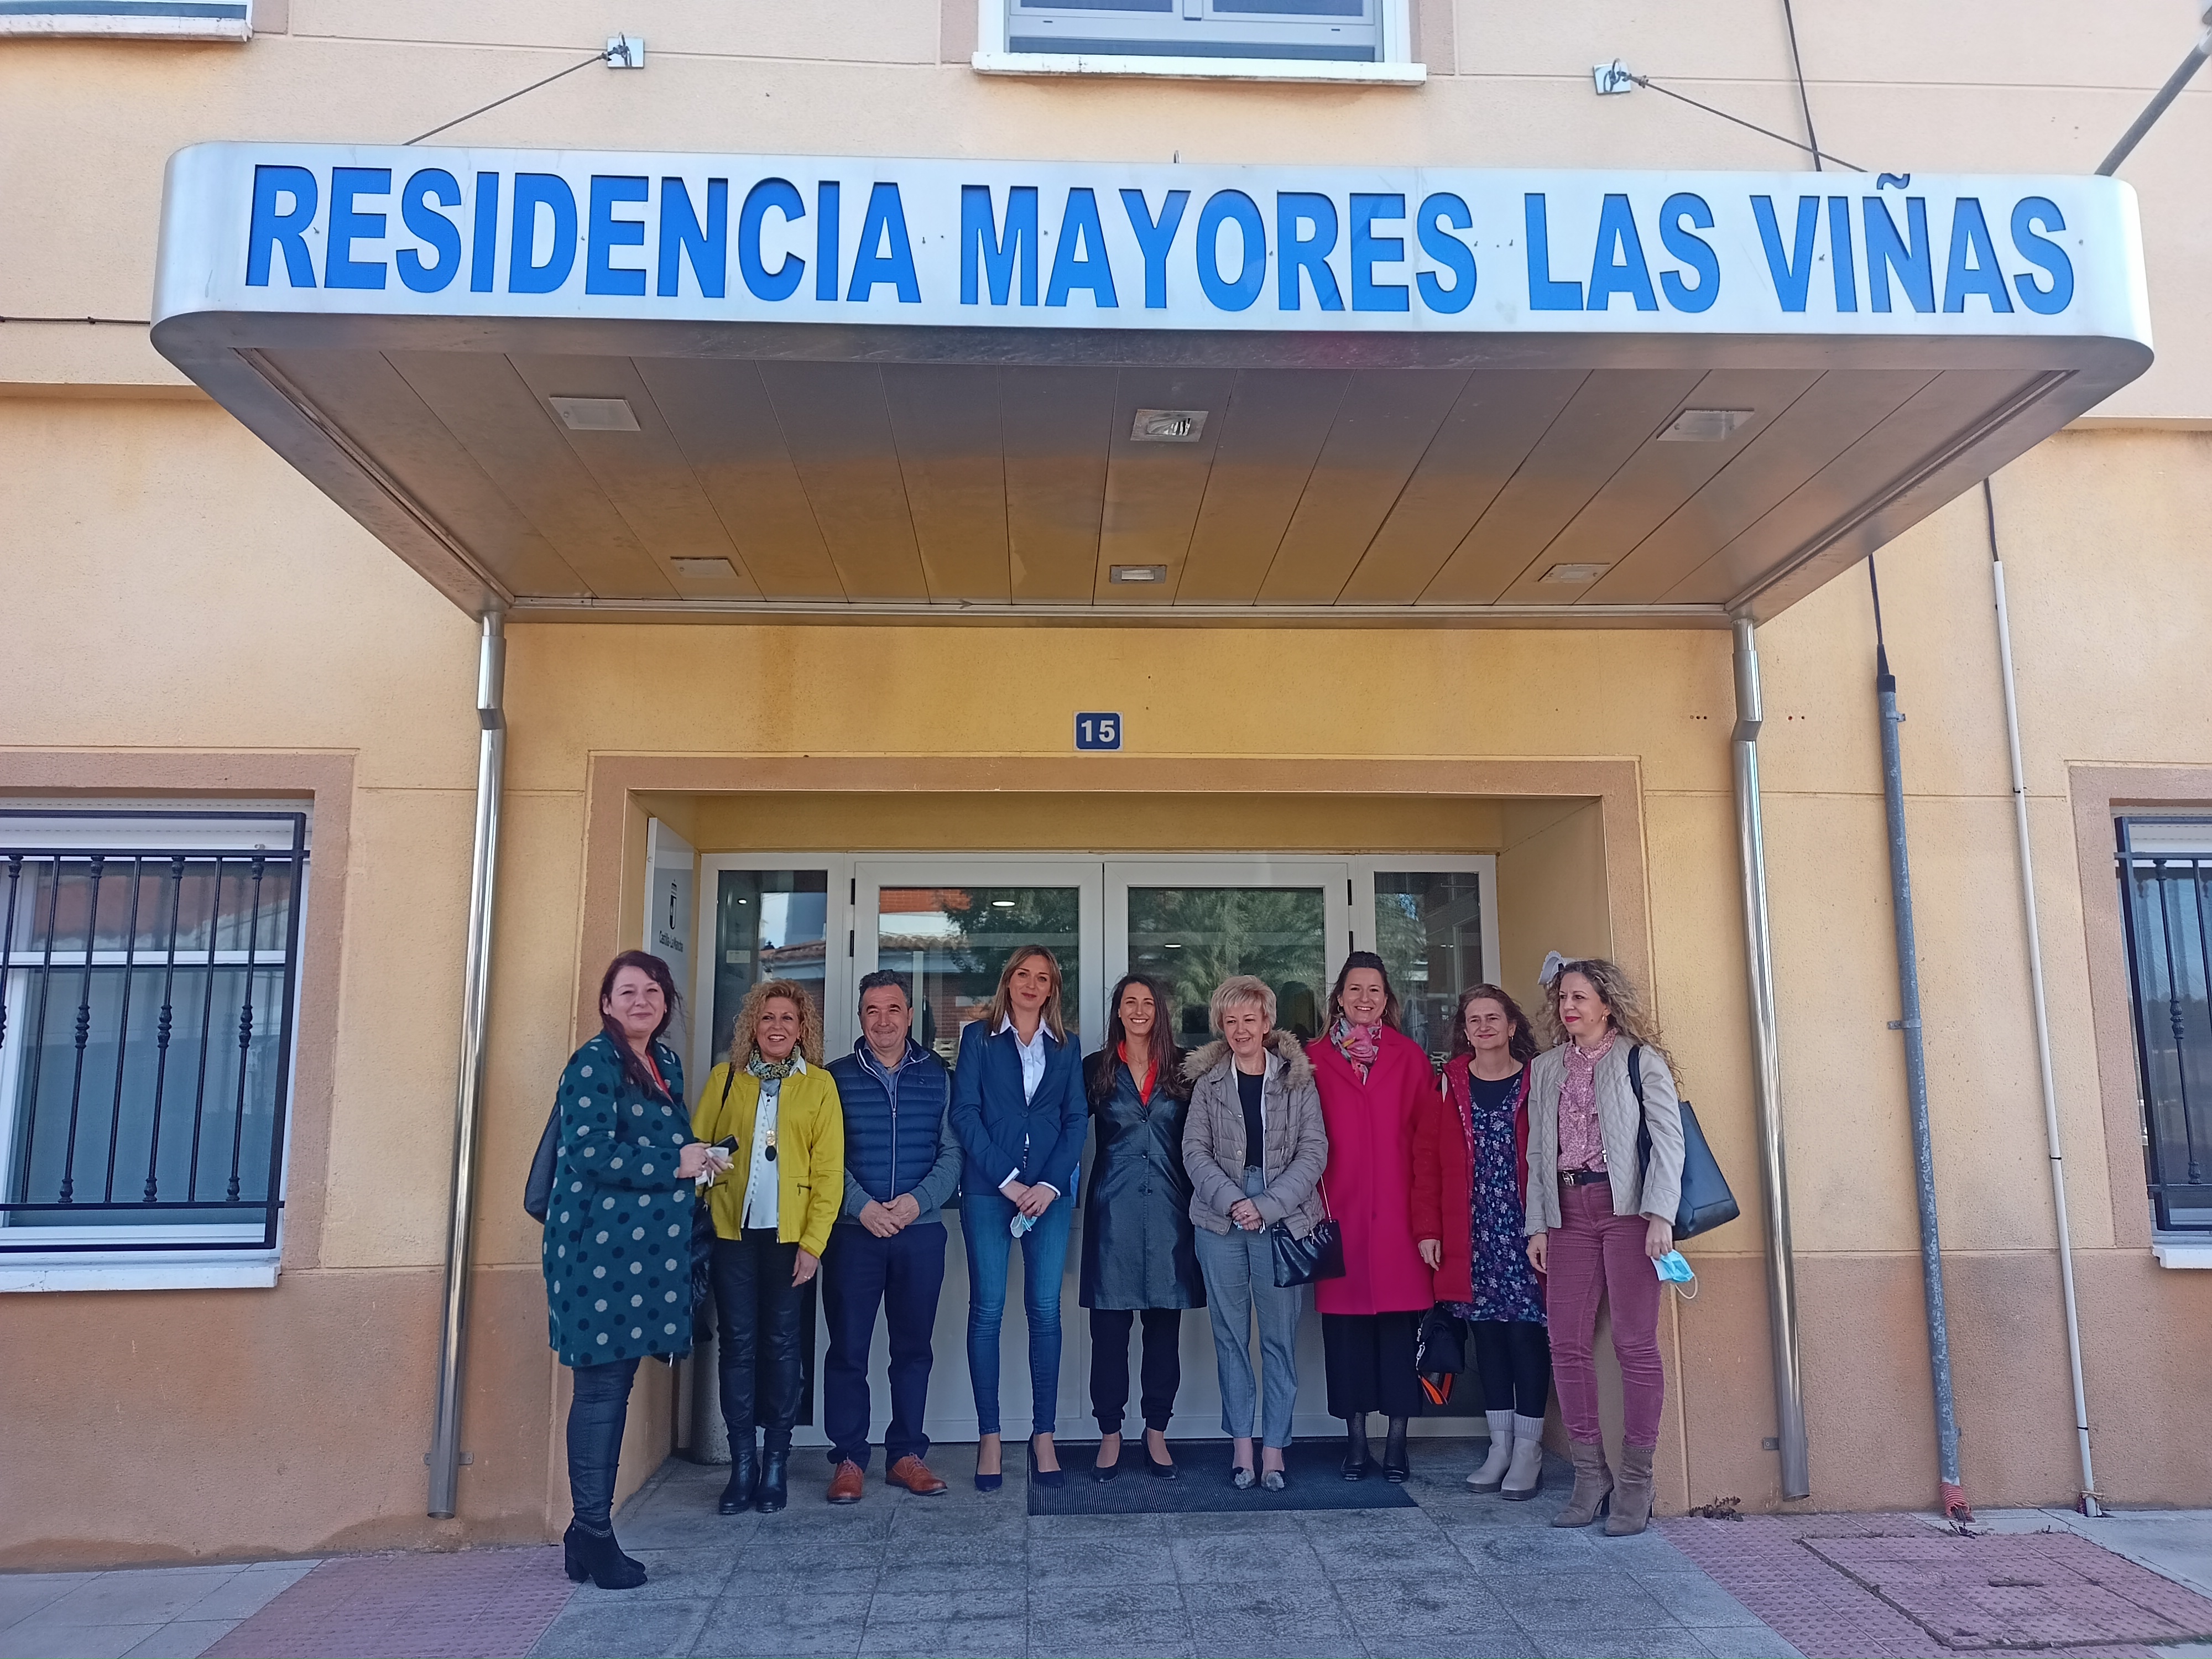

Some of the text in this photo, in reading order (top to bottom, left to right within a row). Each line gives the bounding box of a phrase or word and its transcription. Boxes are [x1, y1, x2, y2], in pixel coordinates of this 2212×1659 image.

[246, 164, 2074, 315] RESIDENCIA MAYORES LAS VIÑAS
[1081, 720, 1115, 742] 15
